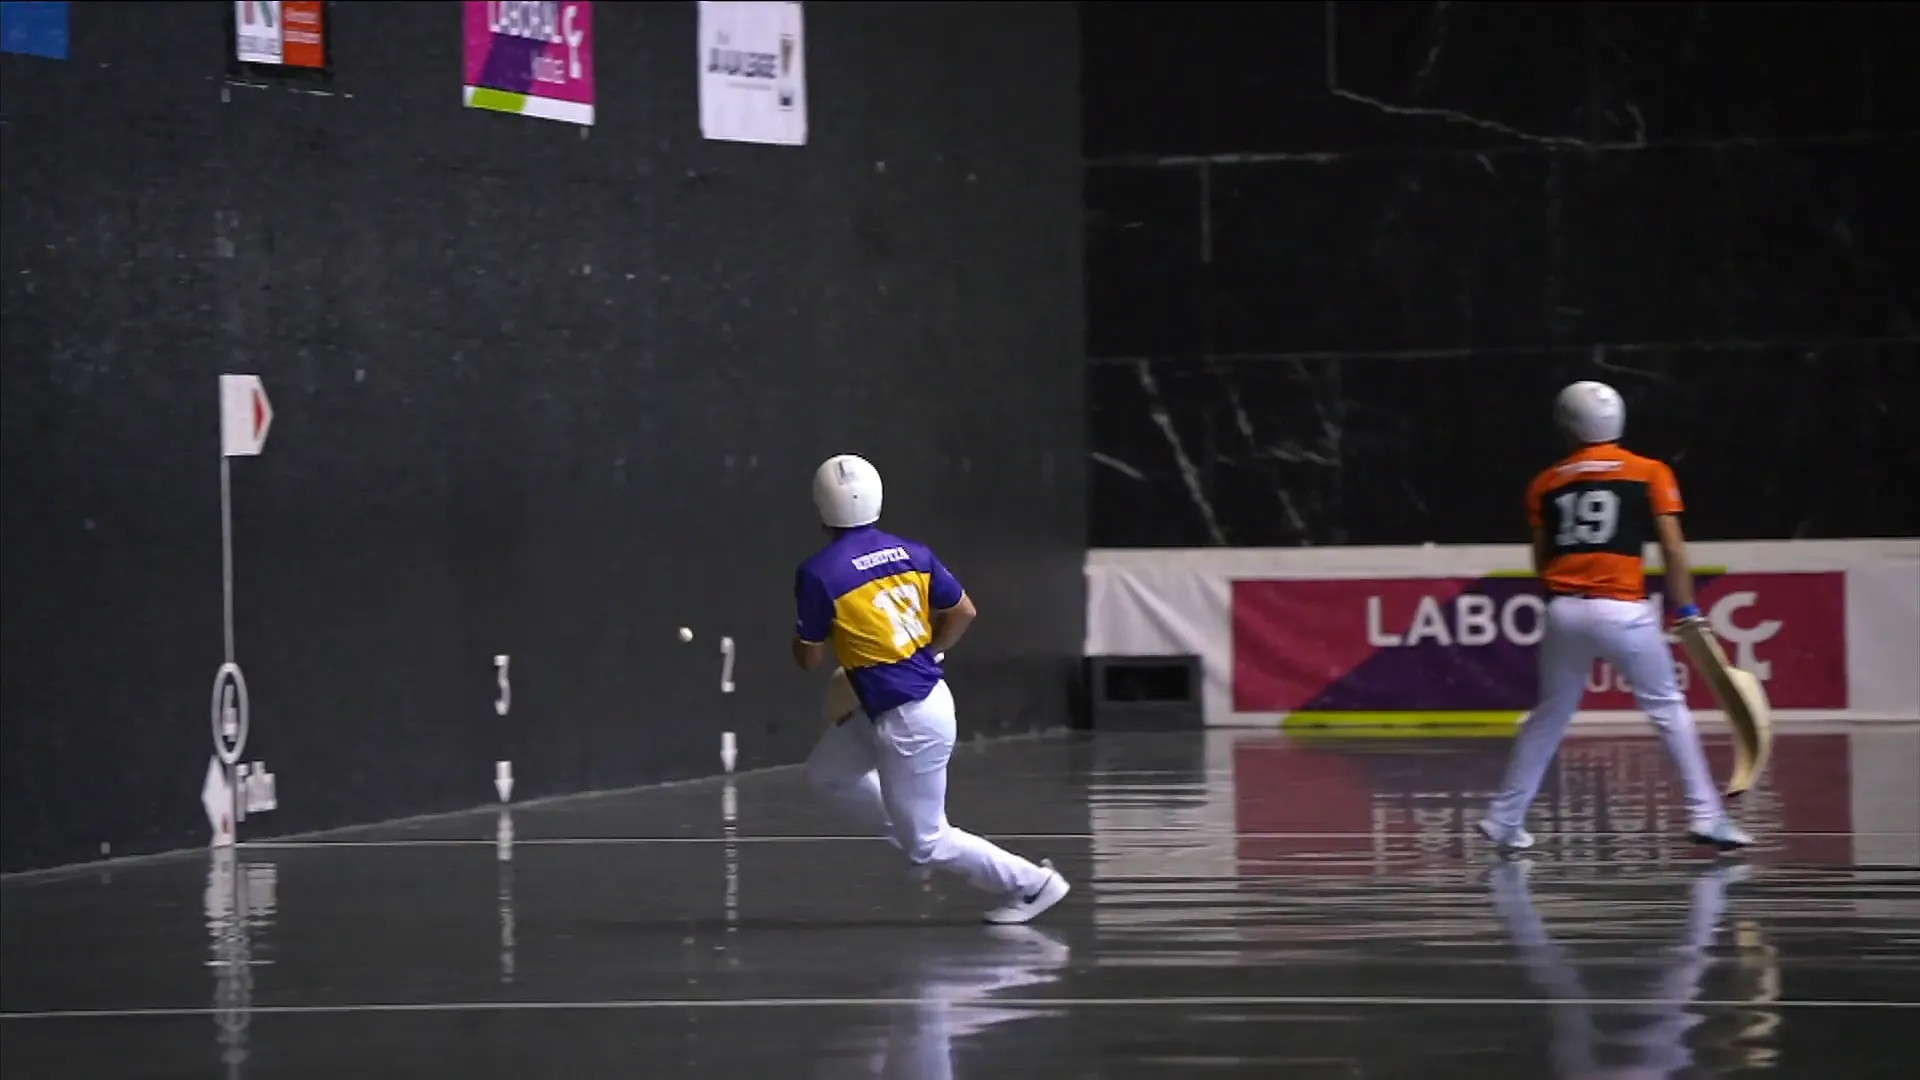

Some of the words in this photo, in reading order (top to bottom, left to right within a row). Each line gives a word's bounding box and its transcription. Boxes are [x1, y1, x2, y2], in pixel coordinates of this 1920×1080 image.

[1554, 489, 1621, 546] 19
[493, 654, 512, 716] 3
[720, 636, 736, 693] 2
